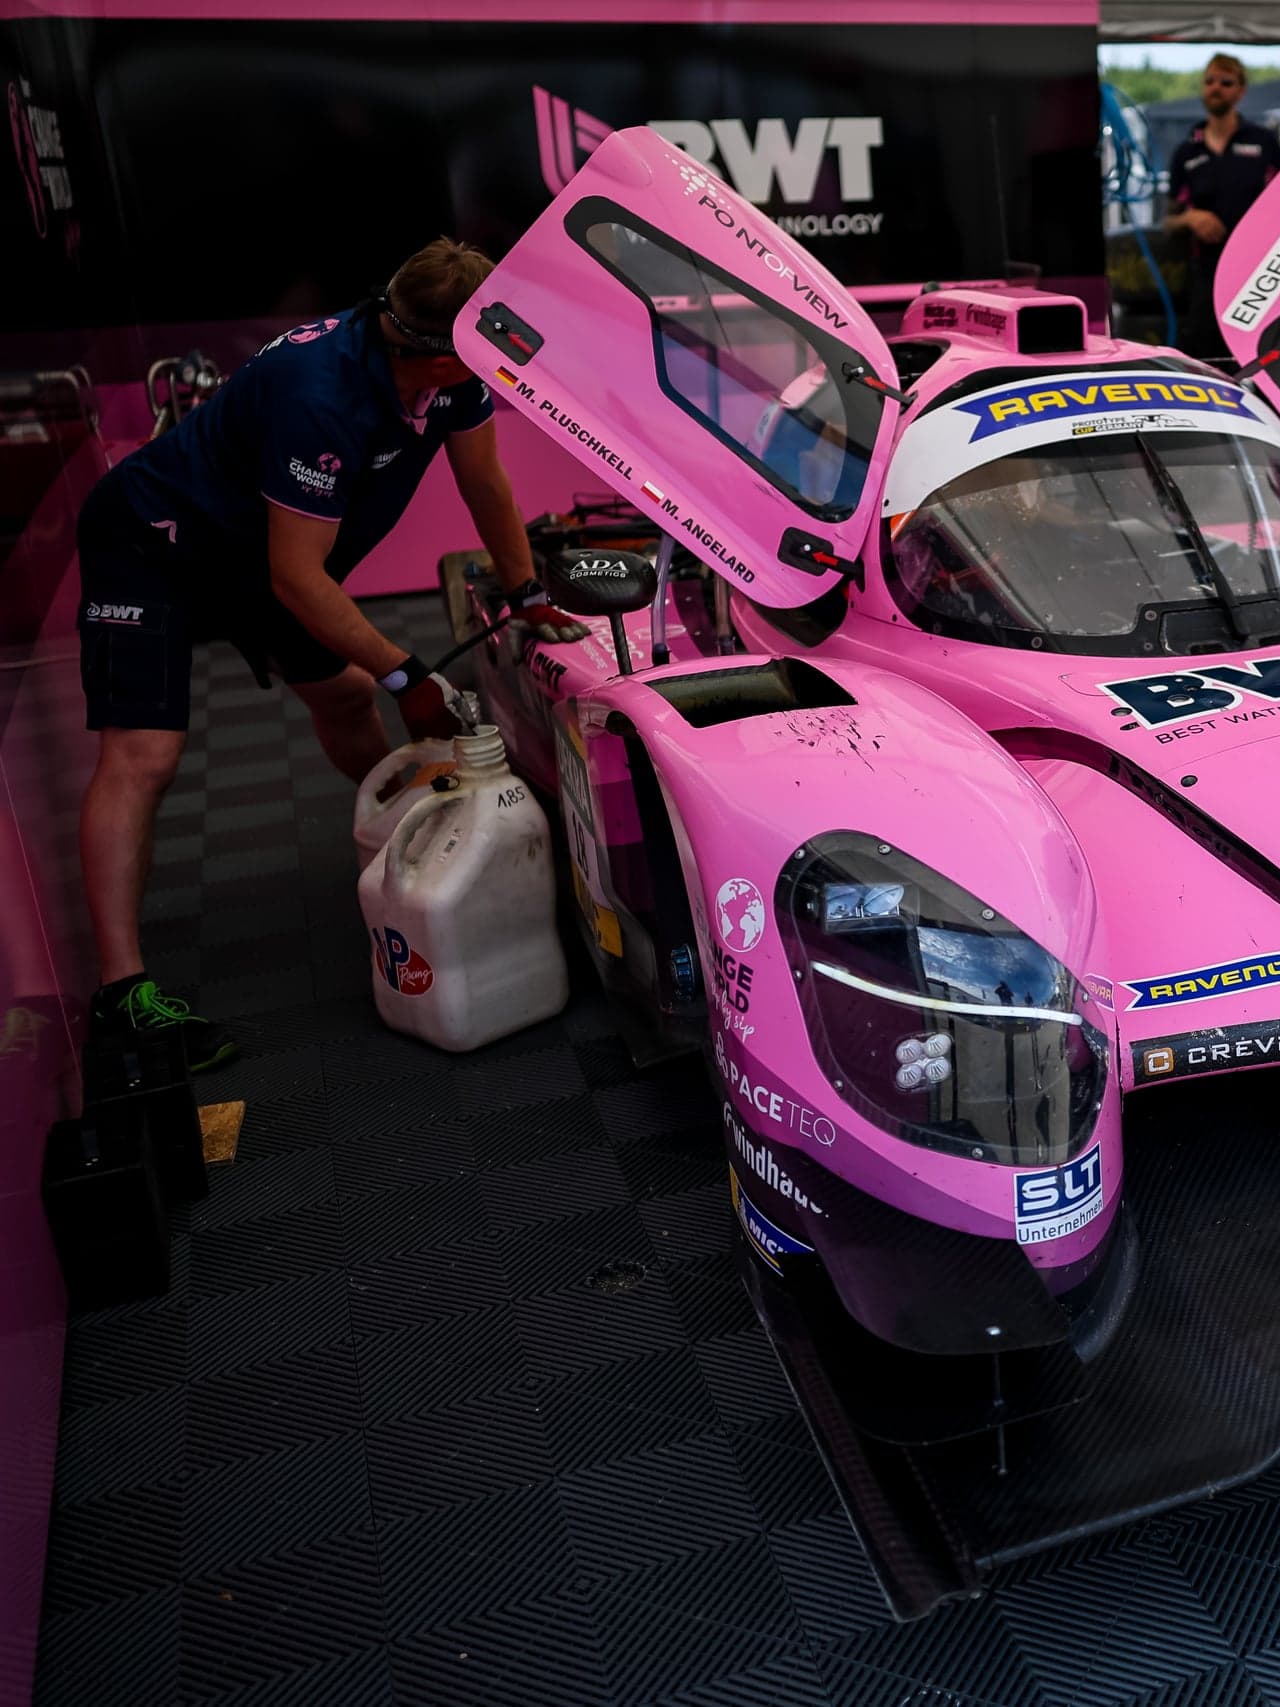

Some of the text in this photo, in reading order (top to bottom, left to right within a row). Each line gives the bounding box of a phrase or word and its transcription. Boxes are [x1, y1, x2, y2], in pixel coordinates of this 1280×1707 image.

[987, 383, 1240, 423] RAVENOL
[538, 398, 635, 481] PLUSCHKELL
[288, 461, 337, 486] CHANGE
[295, 471, 334, 490] WORLD
[680, 514, 757, 585] ANGELARD
[569, 567, 628, 581] COSMETICS
[570, 555, 629, 573] ADA
[99, 604, 144, 620] BWT
[1155, 720, 1217, 745] BEST
[399, 961, 434, 987] Racing
[1022, 1152, 1099, 1211] SLT
